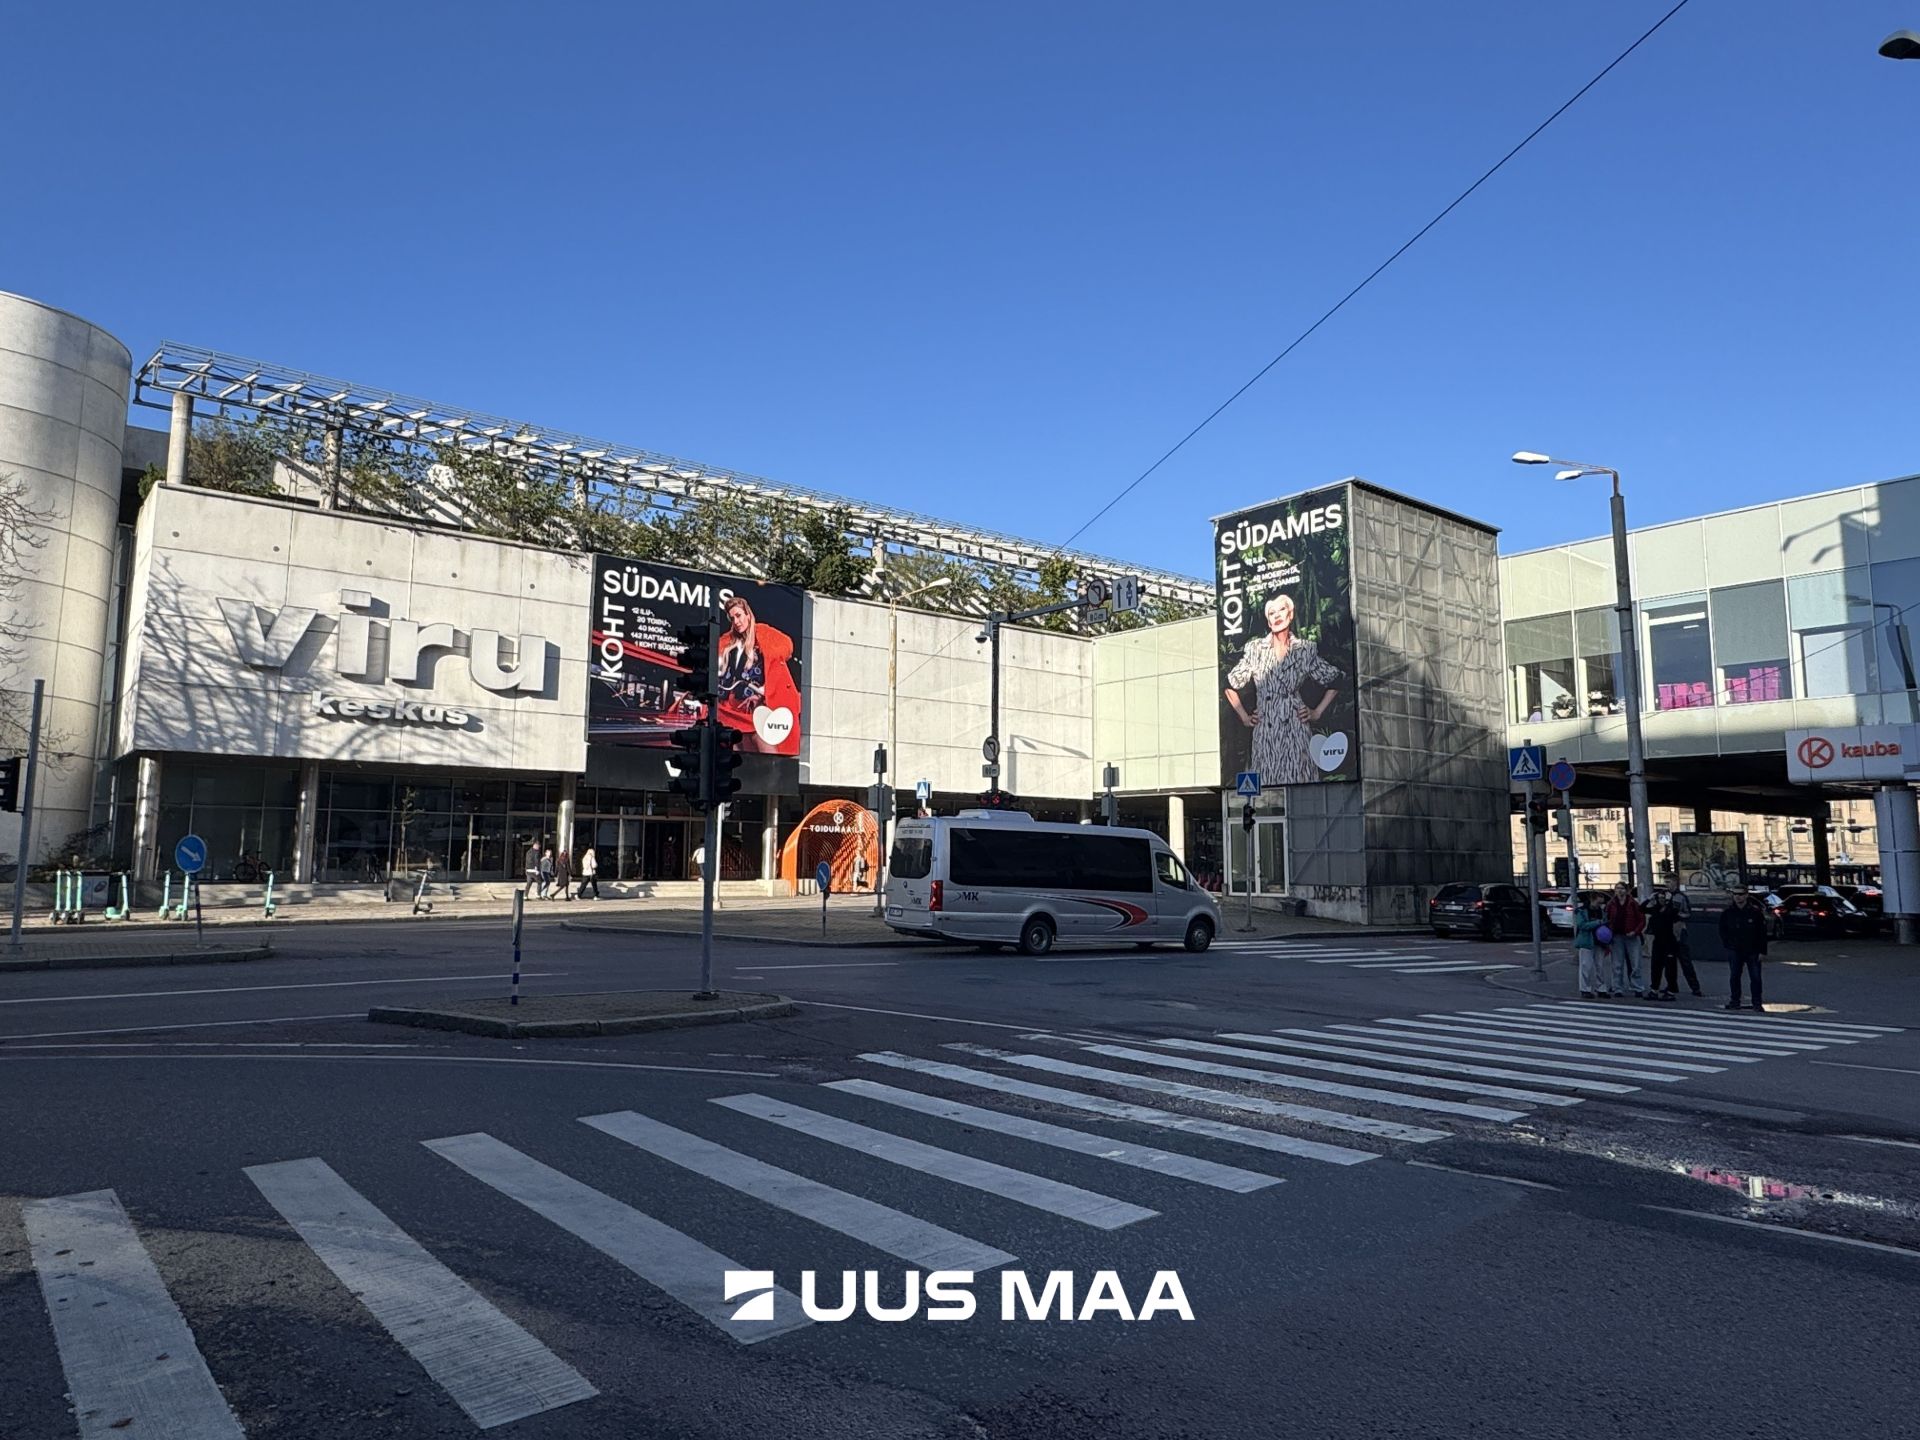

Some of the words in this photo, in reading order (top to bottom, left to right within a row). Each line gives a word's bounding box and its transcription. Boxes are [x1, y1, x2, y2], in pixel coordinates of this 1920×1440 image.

[1221, 504, 1342, 554] SÜDAMES
[1222, 559, 1243, 635] KOHT
[216, 588, 547, 692] viru
[600, 596, 626, 679] KOHT
[631, 632, 643, 640] 142
[312, 690, 469, 726] keskus
[767, 722, 789, 731] viru
[1323, 748, 1345, 756] viru
[1841, 741, 1902, 758] kauba
